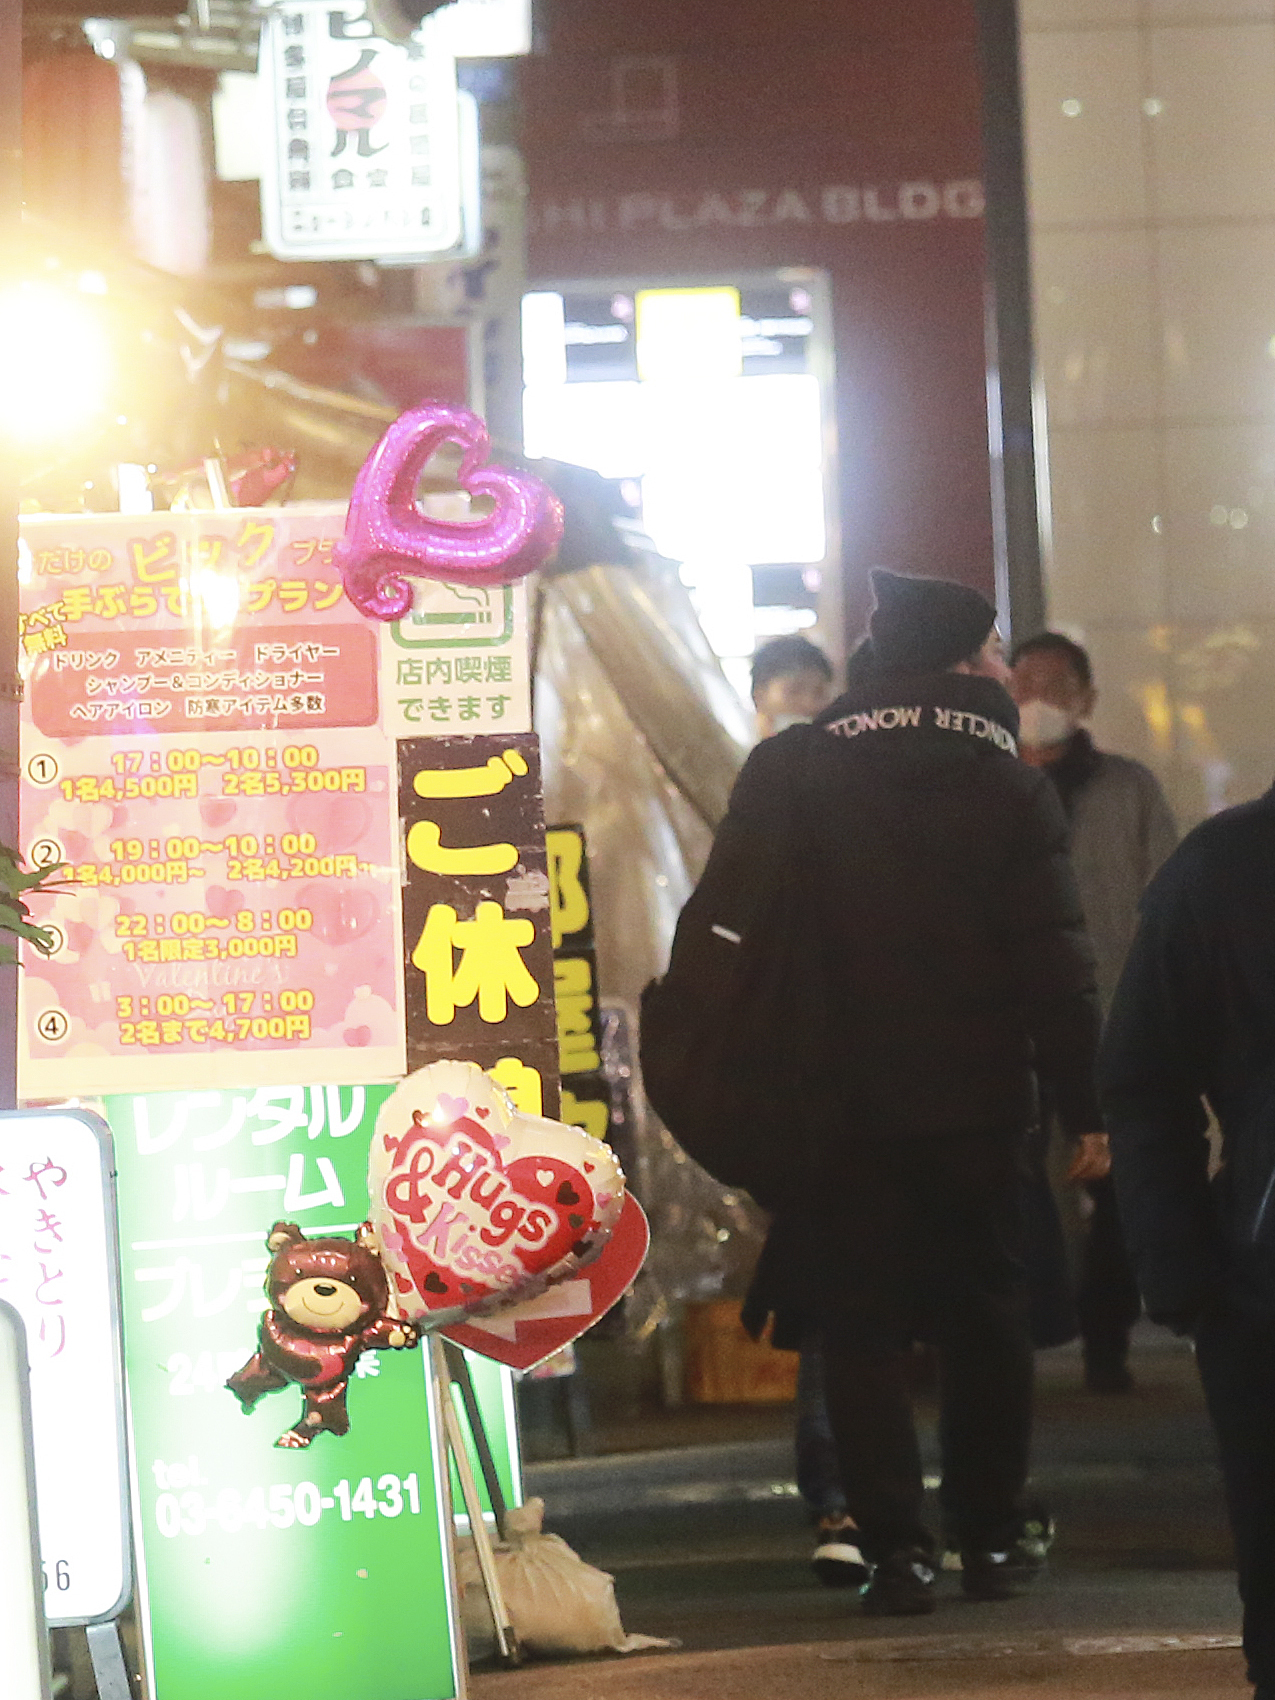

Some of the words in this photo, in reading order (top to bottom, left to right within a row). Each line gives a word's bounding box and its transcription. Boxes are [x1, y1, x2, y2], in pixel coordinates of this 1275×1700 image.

[618, 187, 817, 230] PLAZA
[54, 650, 119, 670] ドリンク
[136, 648, 236, 667] アメニティー
[255, 644, 340, 662] ドライヤー
[396, 654, 513, 687] 店内喫煙
[71, 699, 171, 719] ヘアアイロン
[187, 695, 324, 716] 防寒アイテム多数
[398, 693, 512, 722] できます
[60, 773, 198, 802] 1名4,500円
[222, 767, 367, 796] 2名5,300円
[122, 935, 298, 963] 1名限定3,000円
[406, 748, 543, 1117] ご休
[119, 1014, 311, 1046] 2名まで4,700円
[172, 1154, 345, 1222] ルーム
[431, 1141, 552, 1247] Hugs
[22, 1156, 68, 1358] やきとり
[155, 1474, 420, 1538] 03-6450-1431
